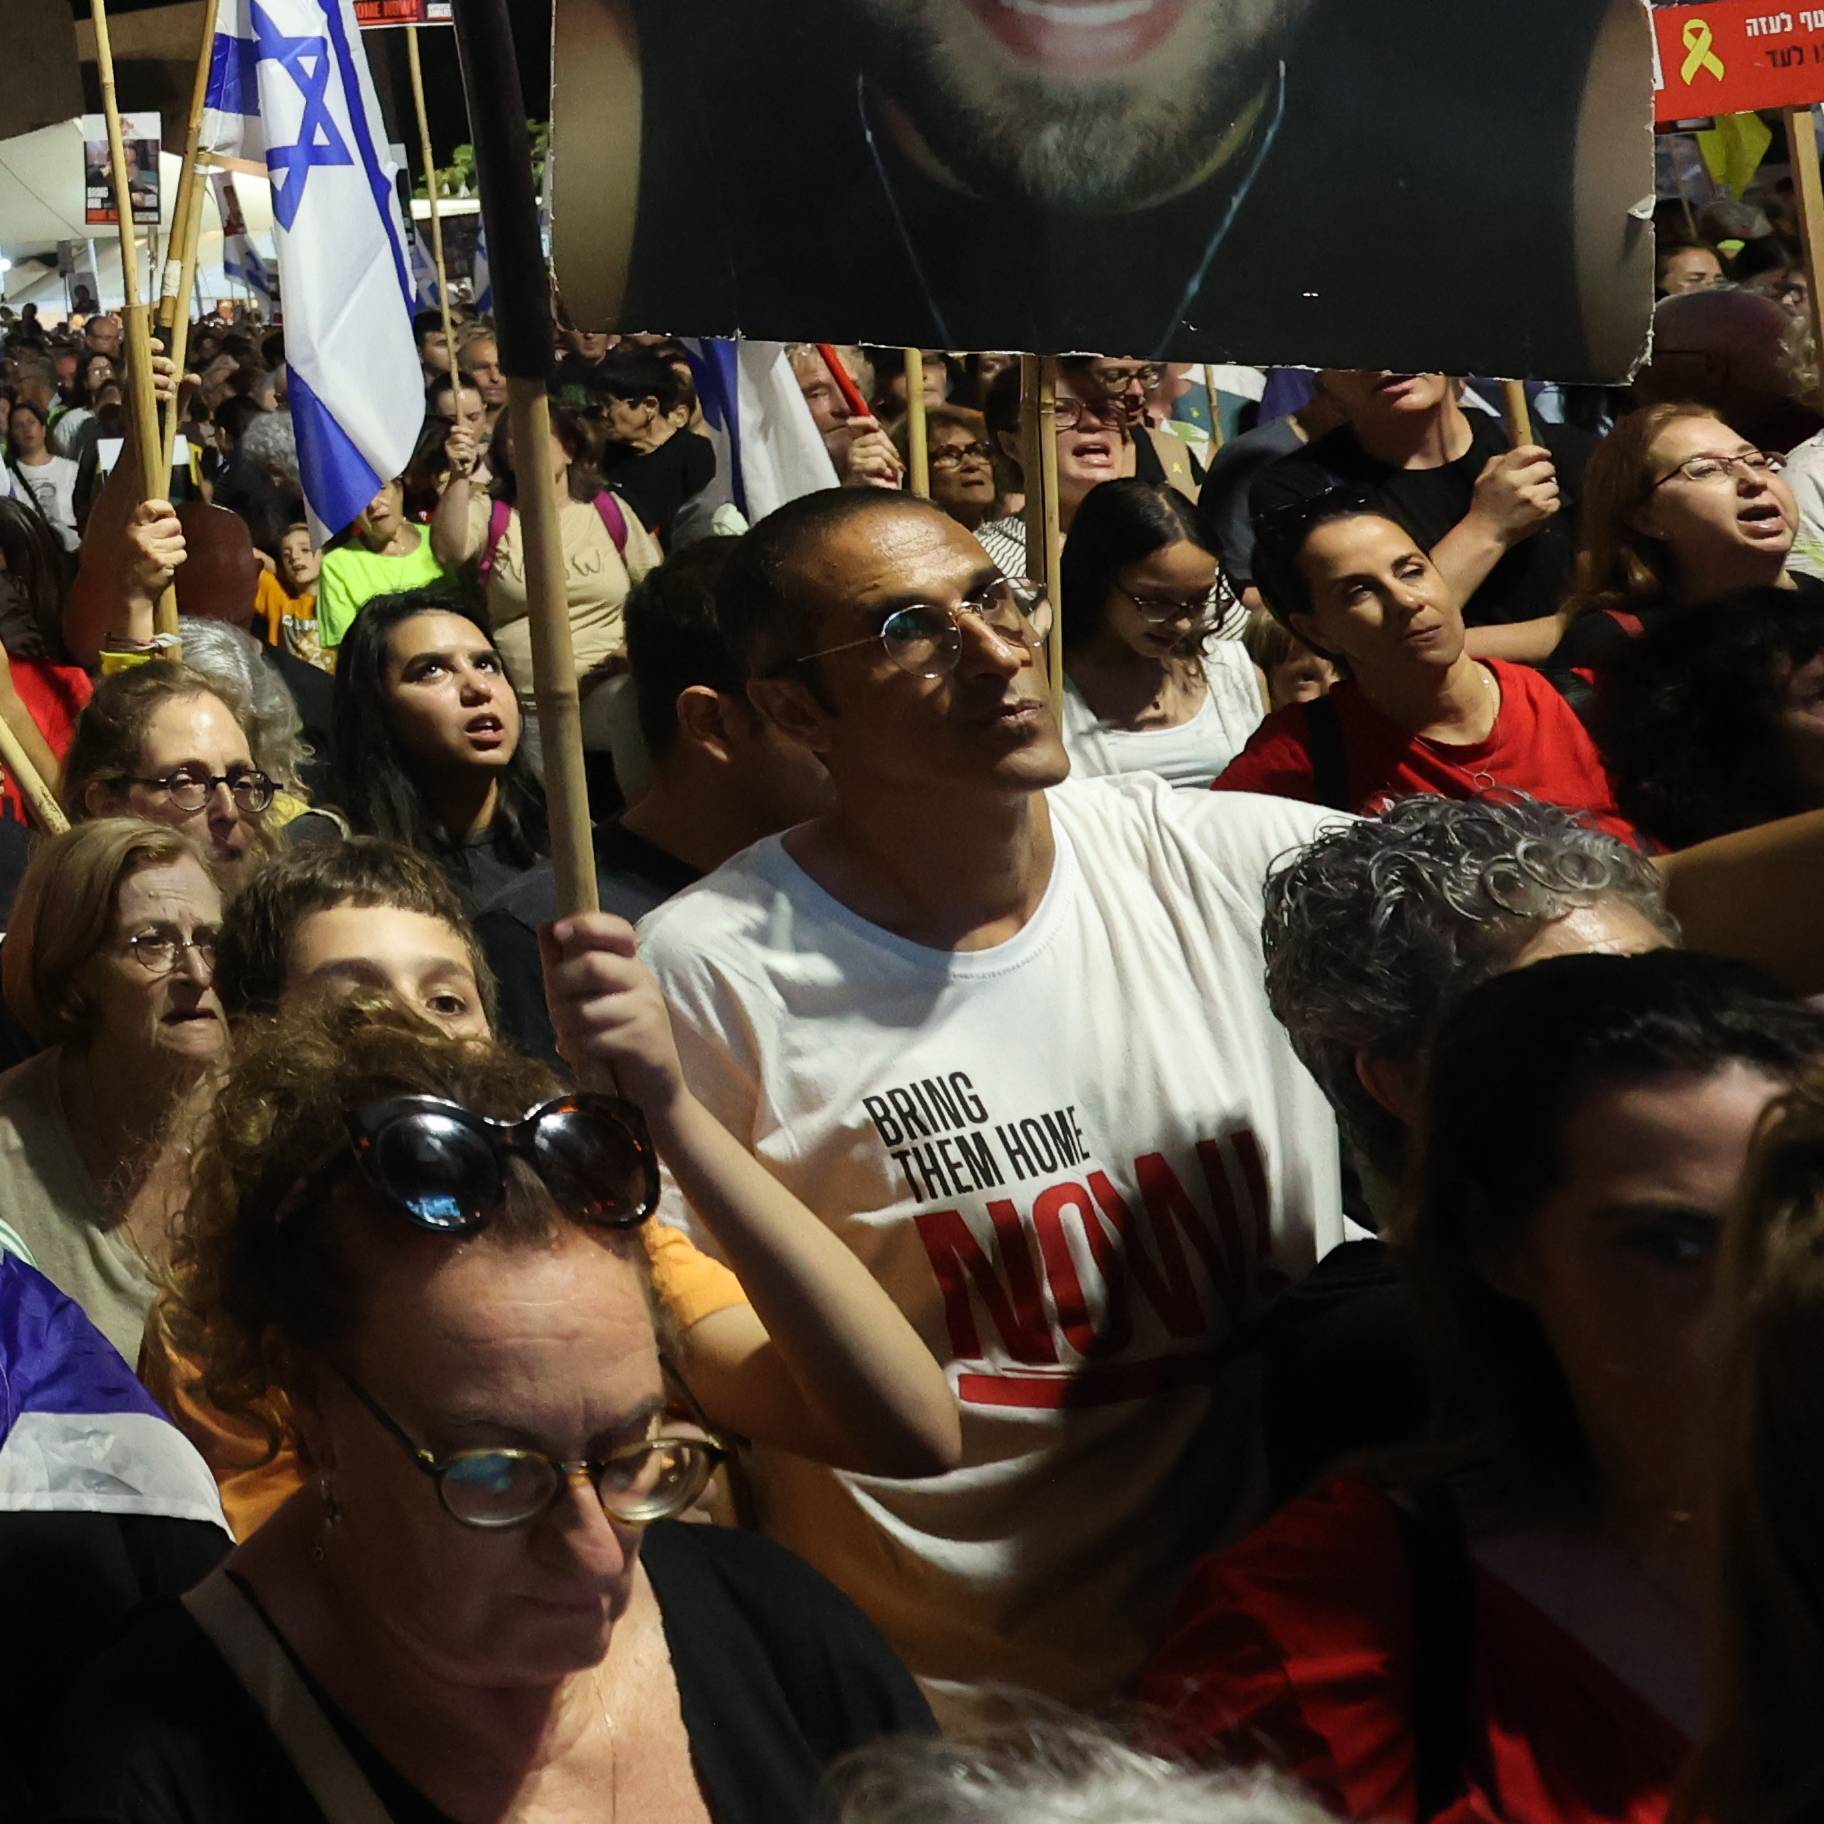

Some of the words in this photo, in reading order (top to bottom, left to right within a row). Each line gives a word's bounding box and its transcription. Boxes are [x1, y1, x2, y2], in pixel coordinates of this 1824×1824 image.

[1746, 12, 1793, 37] לעזה
[863, 1071, 989, 1149] BRING
[891, 1139, 1006, 1205] THEM
[1005, 1105, 1091, 1186] HOME
[914, 1130, 1293, 1365] NOW!
